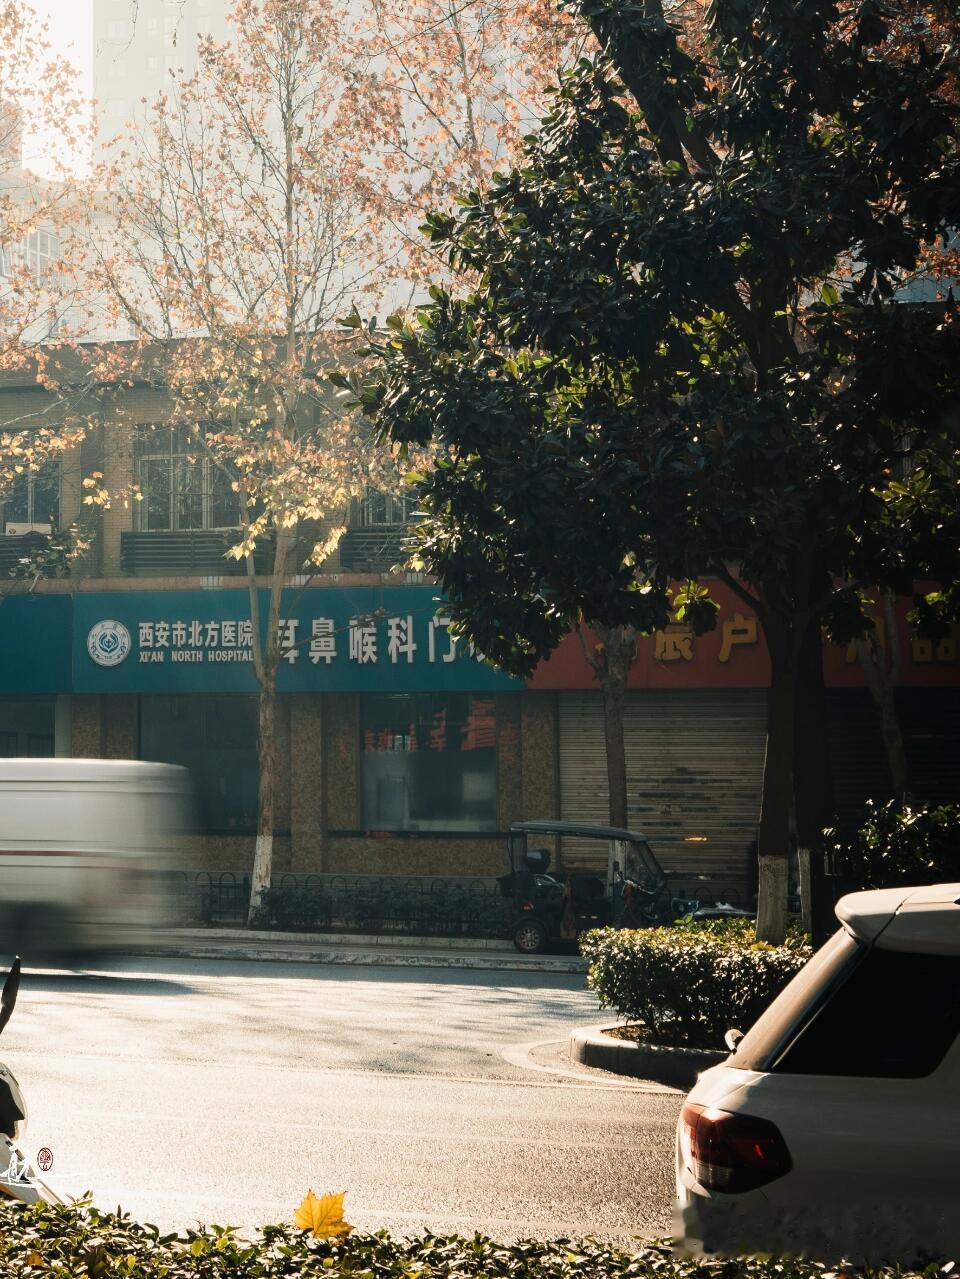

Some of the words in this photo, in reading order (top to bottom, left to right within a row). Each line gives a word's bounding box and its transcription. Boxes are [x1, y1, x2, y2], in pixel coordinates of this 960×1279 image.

[138, 620, 254, 648] 西安市北方医院
[276, 616, 487, 665] 耳鼻喉科门
[171, 651, 203, 663] NORTH
[208, 650, 254, 663] HOSPITAL
